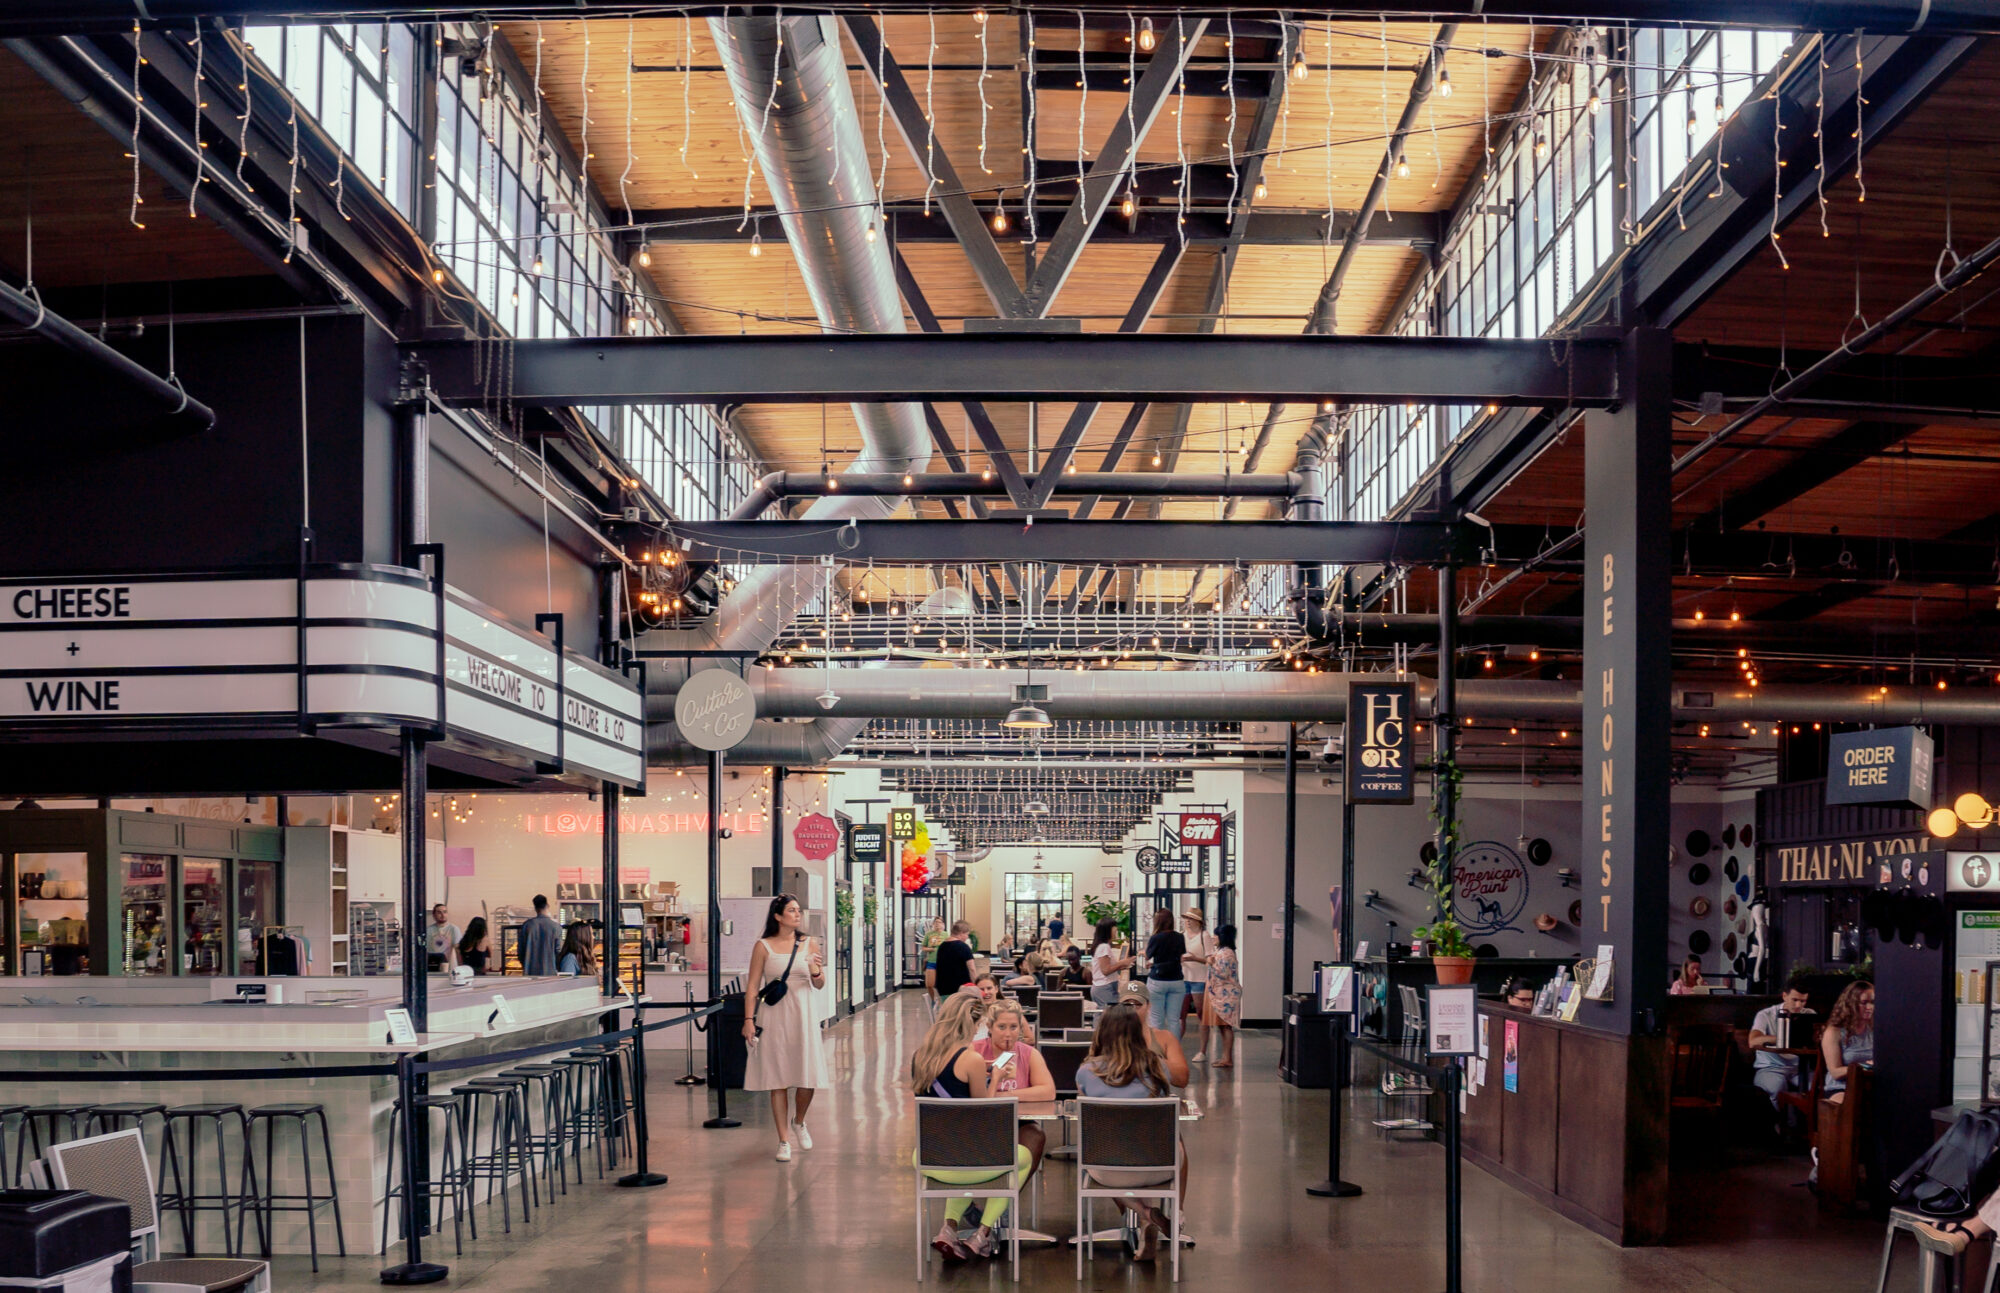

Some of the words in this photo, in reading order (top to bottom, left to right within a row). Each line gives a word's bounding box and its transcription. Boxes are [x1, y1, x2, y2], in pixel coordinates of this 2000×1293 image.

[13, 587, 130, 619] CHEESE
[1602, 553, 1614, 636] BE
[66, 641, 80, 656] +
[25, 680, 120, 711] WINE
[467, 655, 522, 703] WELCOME
[531, 683, 545, 711] TO
[567, 698, 599, 733] CULTURE
[604, 716, 609, 734] &
[614, 720, 625, 742] CO
[682, 682, 744, 727] Culture
[1843, 745, 1896, 767] ORDER
[1360, 782, 1403, 791] COFFEE
[1848, 767, 1889, 786] HERE
[1600, 668, 1614, 932] HONEST
[526, 814, 532, 832] I
[543, 814, 604, 833] LOVE
[619, 814, 762, 833] NASHVLE
[797, 832, 835, 840] DAUGHTERS
[854, 841, 881, 849] BRIGHT
[855, 833, 881, 841] JUDITH
[1453, 866, 1523, 886] American
[1461, 878, 1509, 899] Paint
